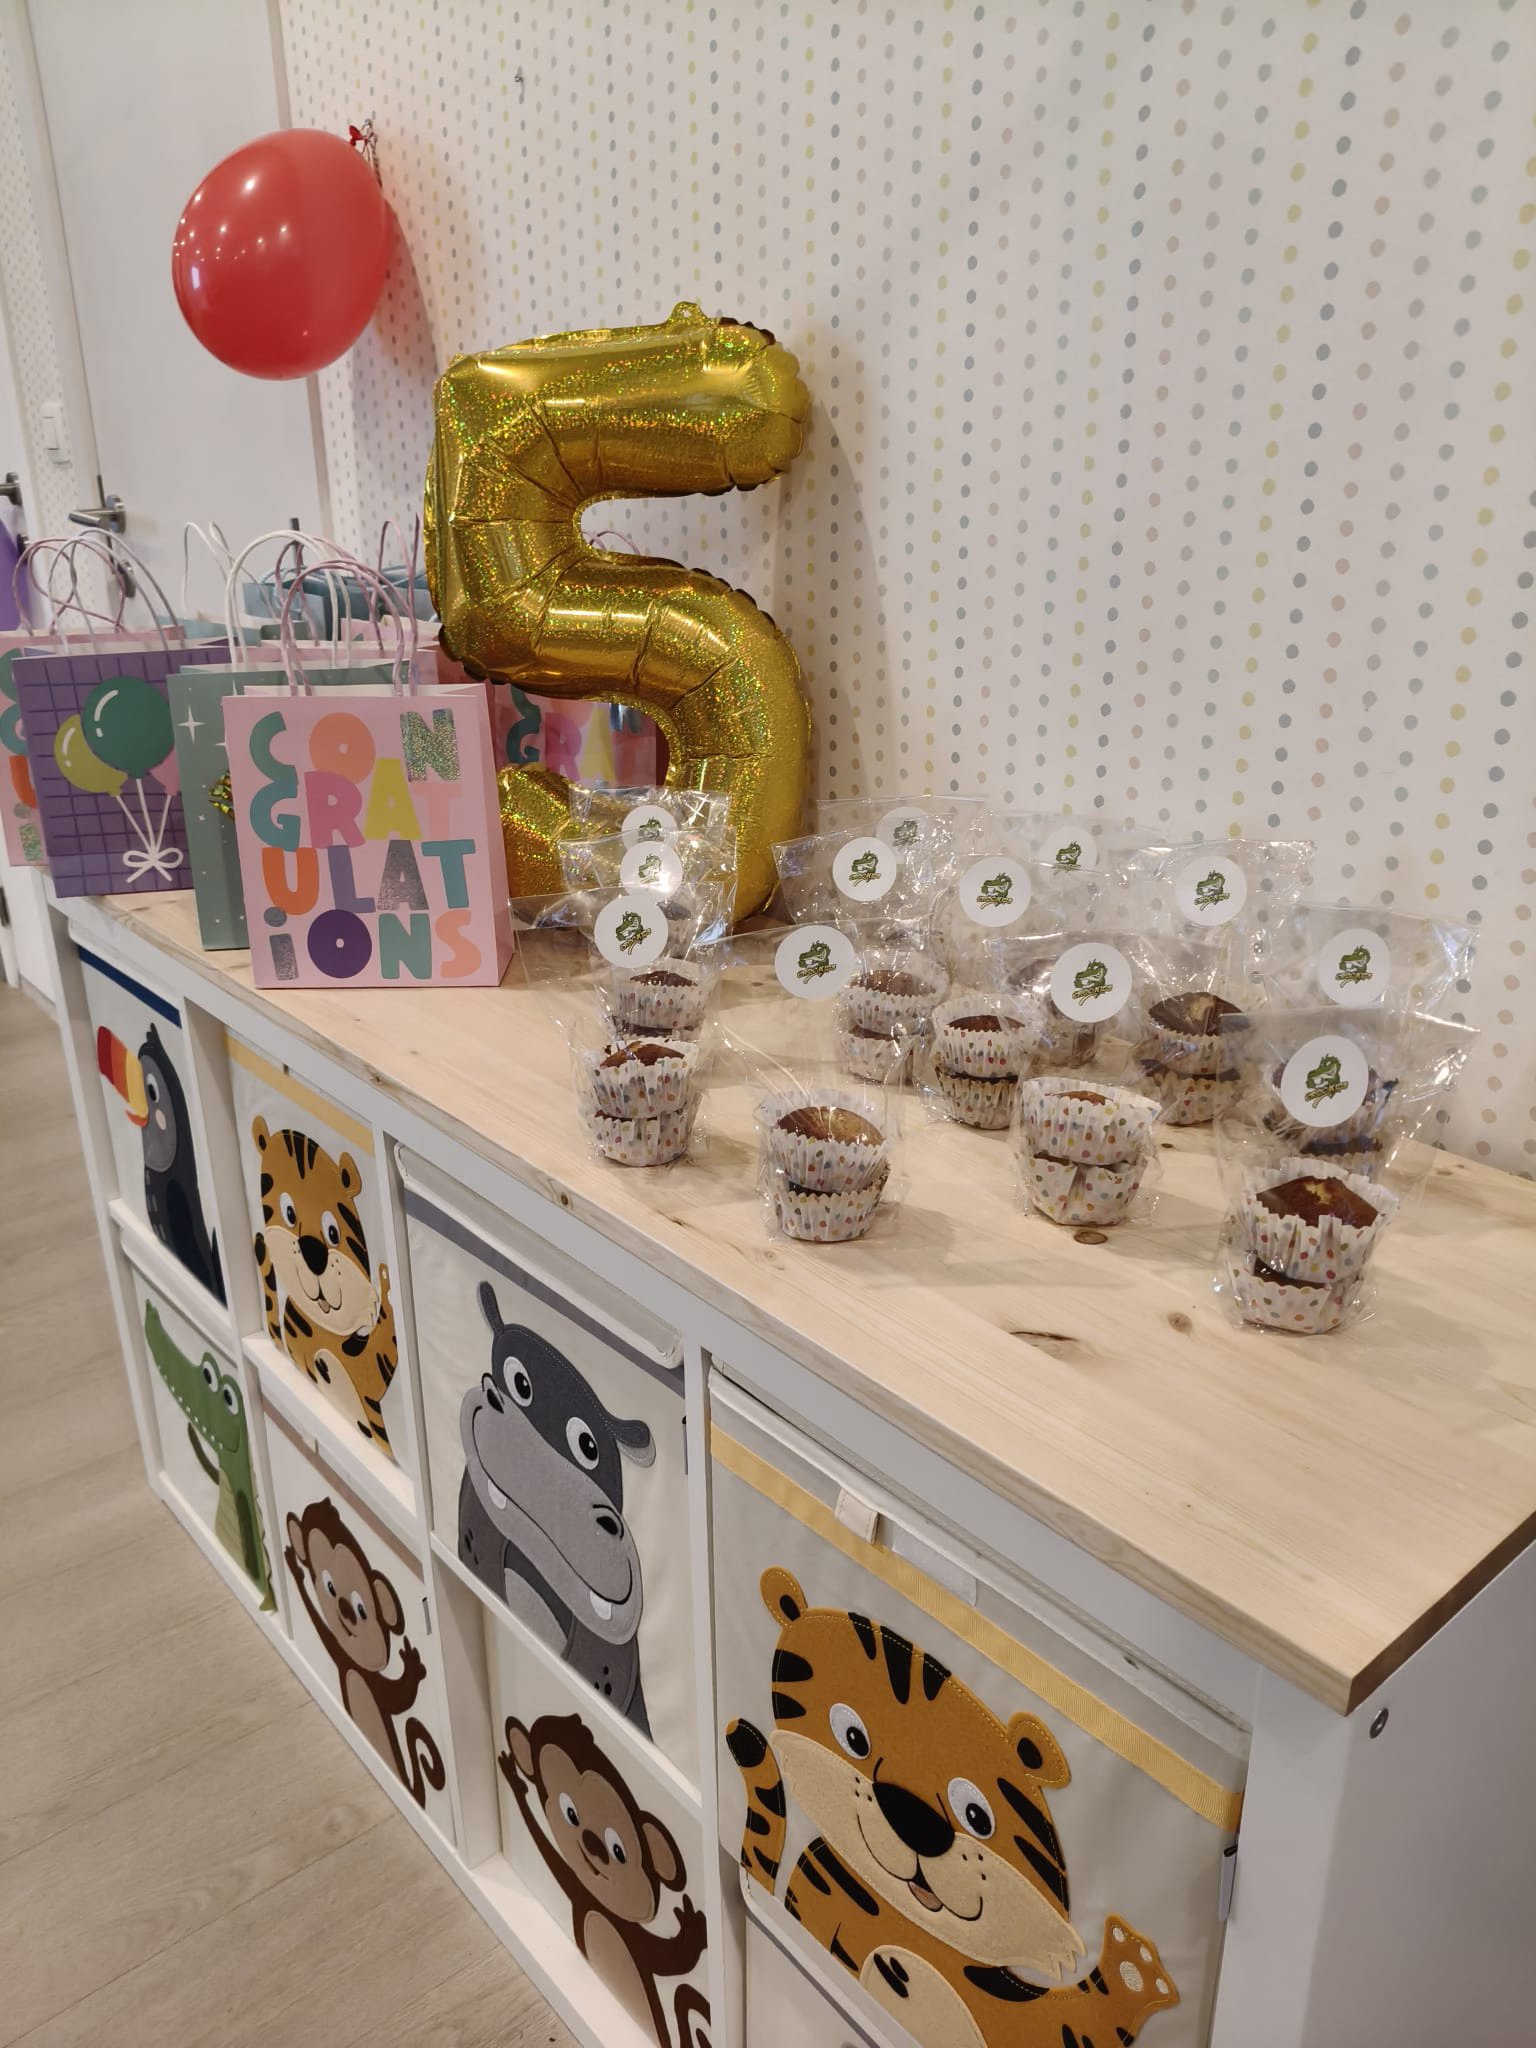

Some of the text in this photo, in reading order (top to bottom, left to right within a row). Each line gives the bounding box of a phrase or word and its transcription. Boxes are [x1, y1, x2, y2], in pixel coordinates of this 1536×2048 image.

[249, 708, 461, 785] CON
[249, 757, 463, 852] GRAT
[261, 838, 477, 916] ULAT
